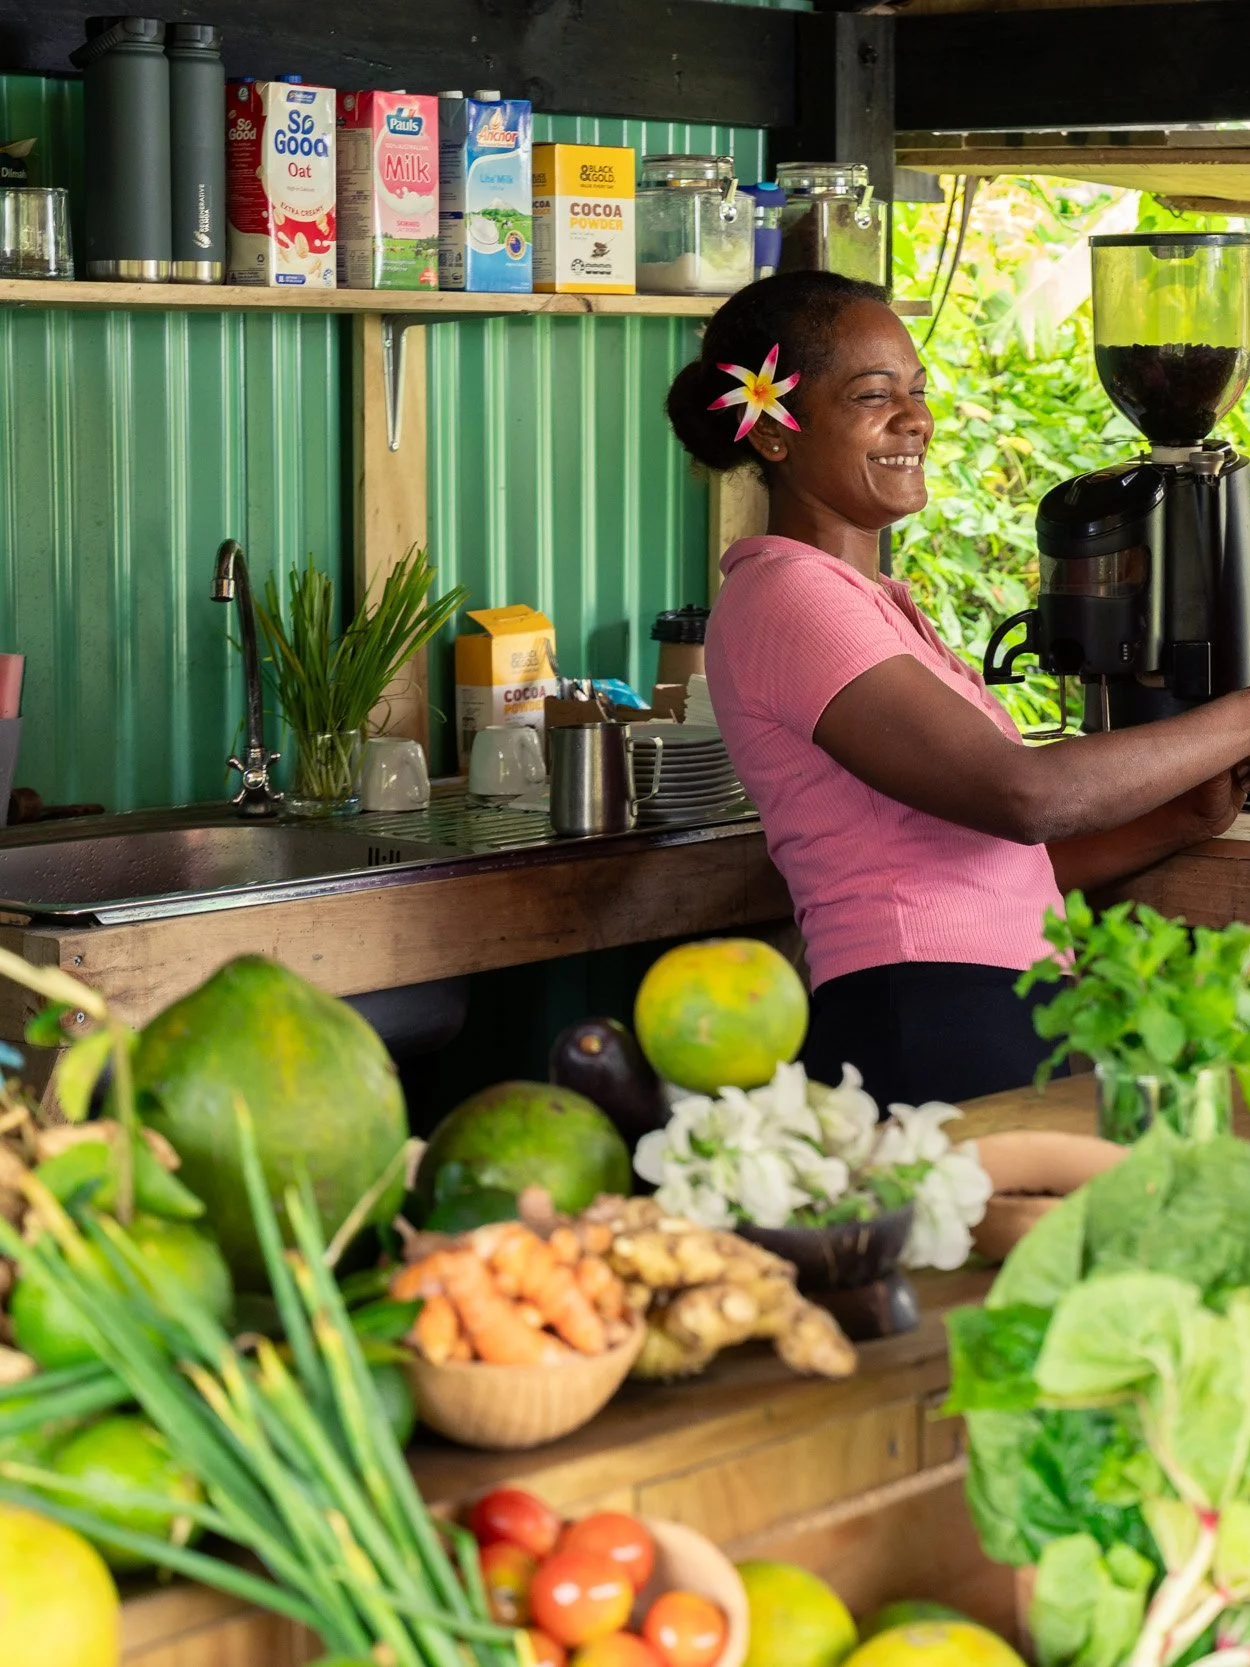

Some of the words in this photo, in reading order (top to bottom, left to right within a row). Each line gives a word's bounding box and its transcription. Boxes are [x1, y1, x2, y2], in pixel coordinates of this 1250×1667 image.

[236, 118, 252, 130] So
[288, 109, 315, 135] So
[389, 118, 420, 131] Pauls
[228, 127, 257, 140] Good
[288, 162, 312, 178] Oat
[384, 153, 431, 183] Milk
[589, 165, 613, 174] BLACK
[592, 173, 615, 183] GOLD
[570, 202, 622, 218] COCOA
[569, 217, 623, 231] POWDER
[504, 686, 546, 702] COCOA
